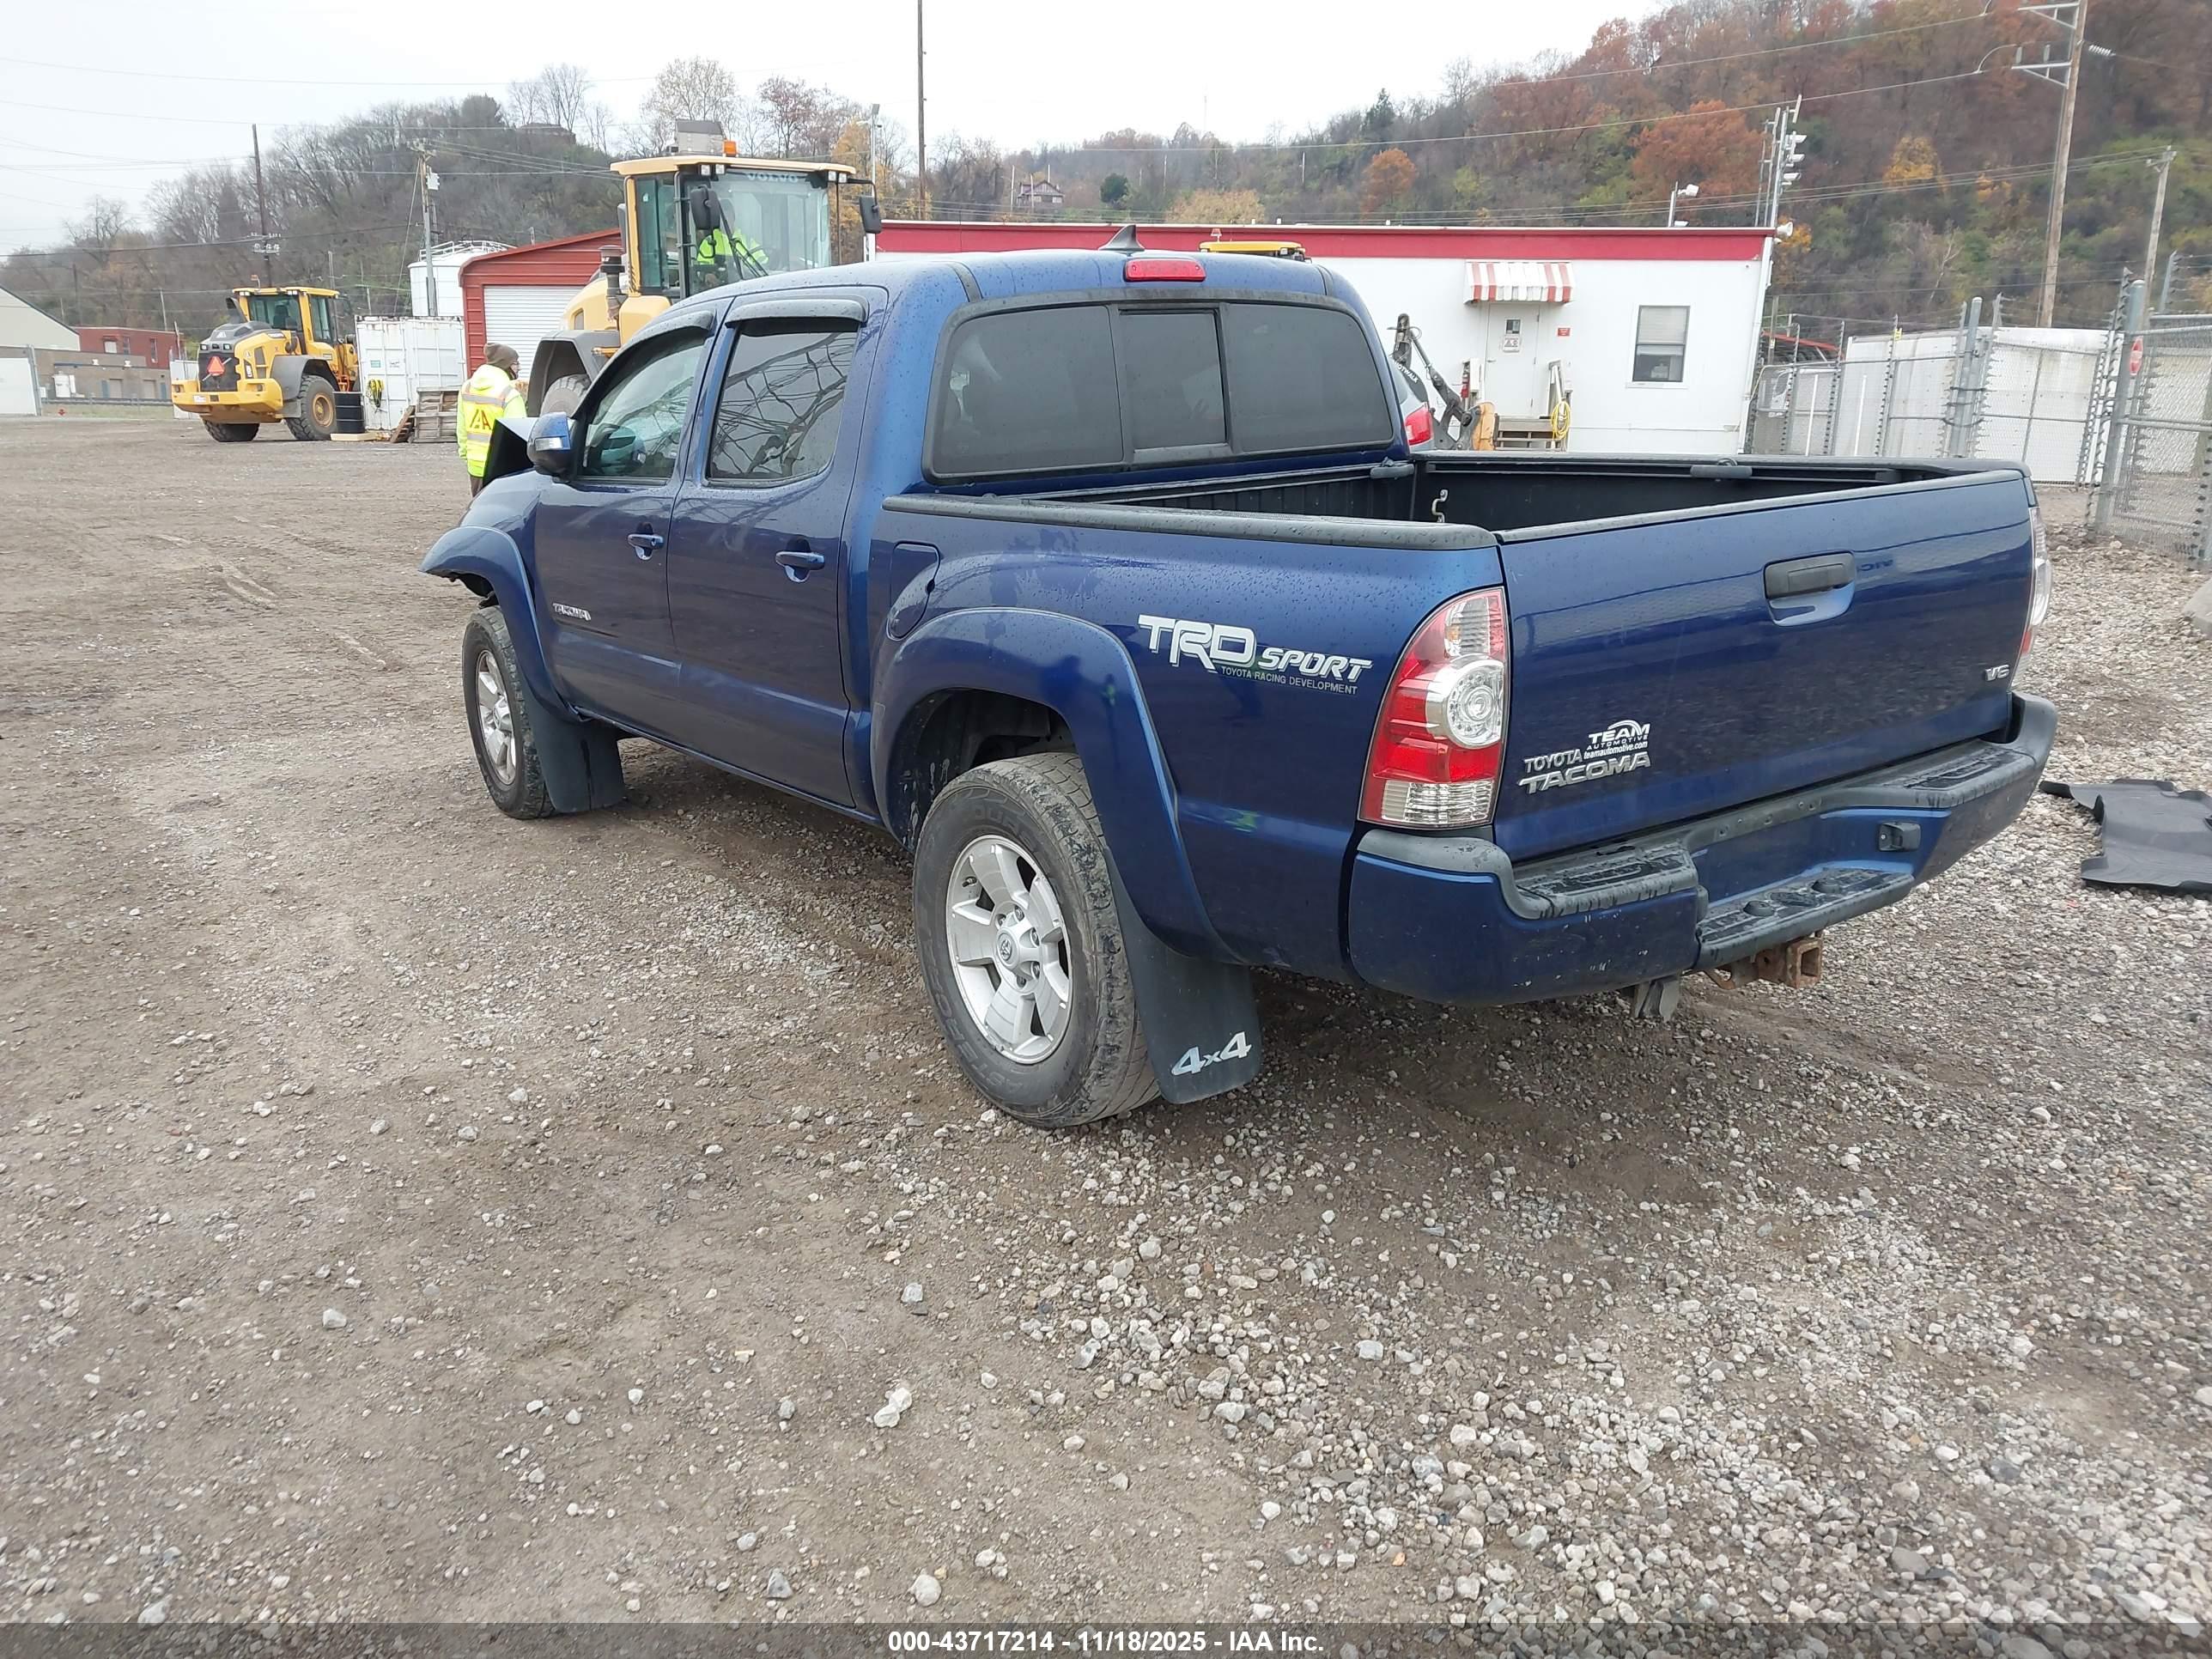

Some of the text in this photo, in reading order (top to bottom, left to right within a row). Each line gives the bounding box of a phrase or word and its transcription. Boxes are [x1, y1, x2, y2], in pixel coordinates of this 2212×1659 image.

[1138, 614, 1373, 683] TRD SPORT
[1221, 665, 1358, 695] TOYOTA RACING DEVELOPMENT
[1984, 664, 2010, 682] V6
[1586, 734, 1648, 750] AUTOMOTIVE
[1588, 723, 1650, 744] TEAM
[1524, 749, 1583, 774] TOYOTA
[1583, 741, 1648, 760] teamautomotive.com
[1517, 751, 1650, 794] TACOMA
[1170, 1031, 1252, 1076] 4x4
